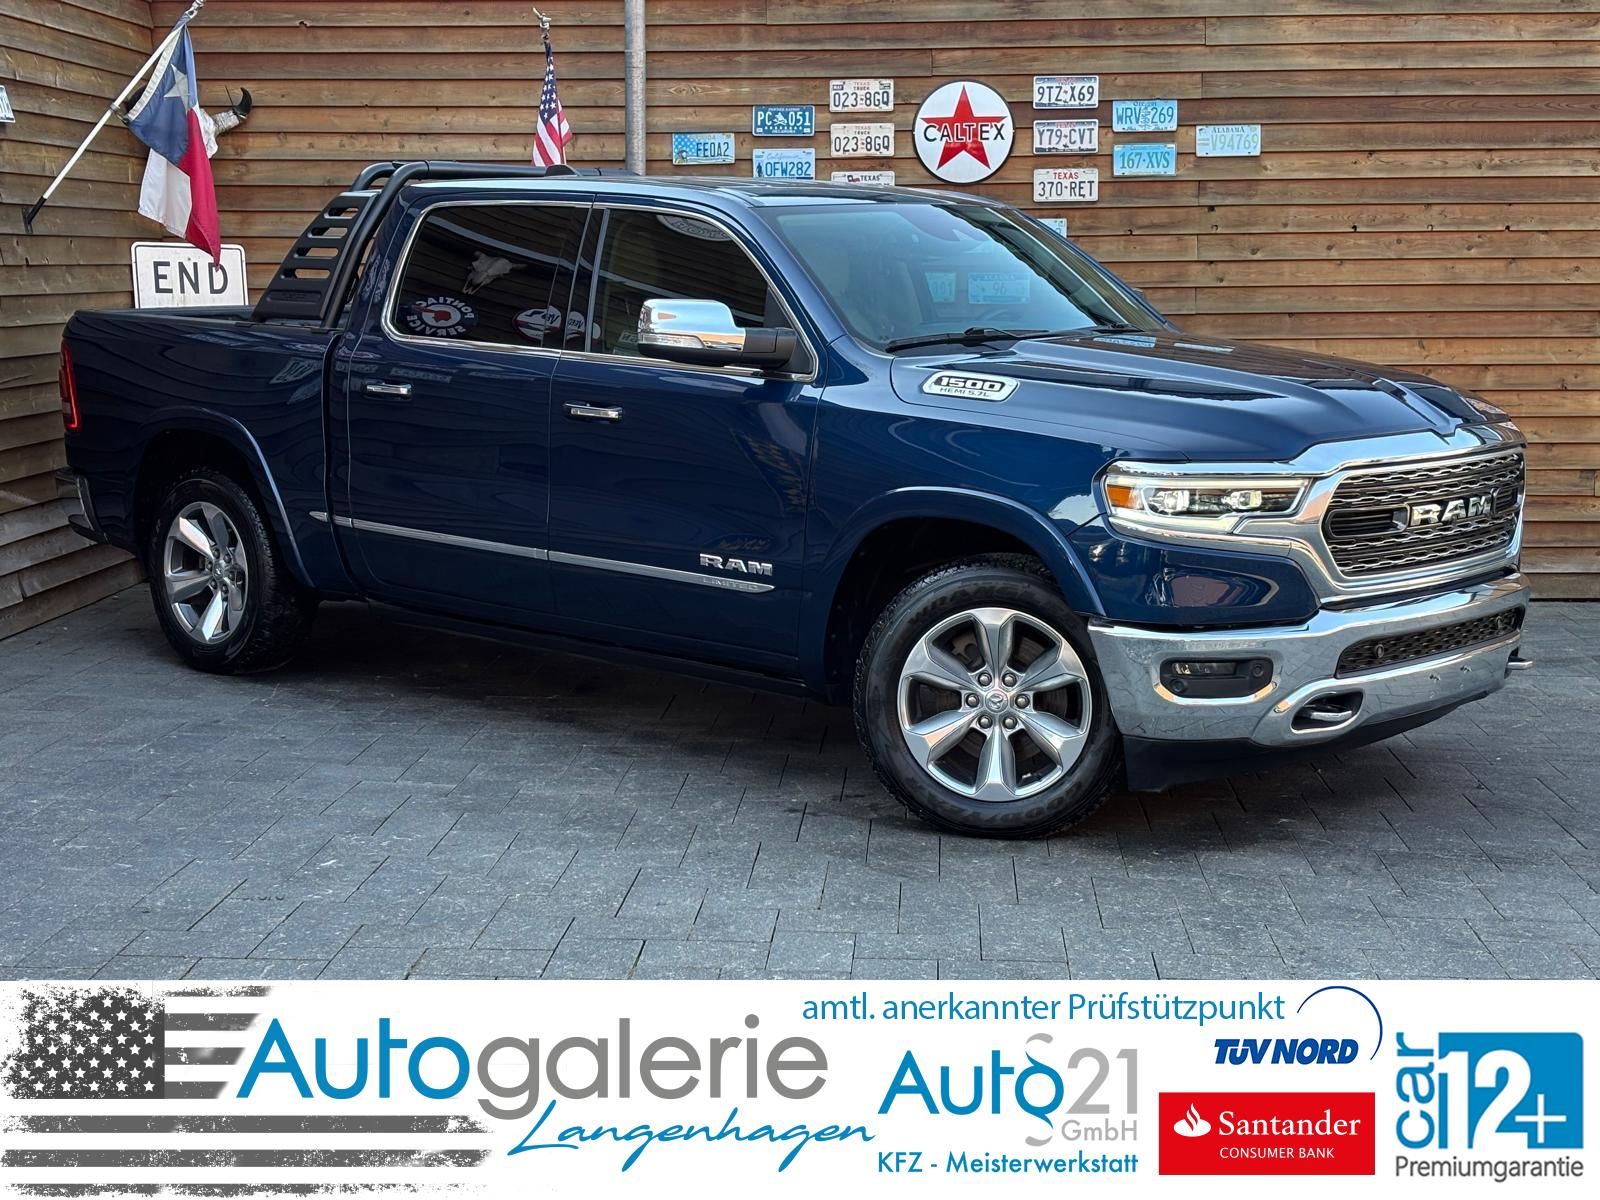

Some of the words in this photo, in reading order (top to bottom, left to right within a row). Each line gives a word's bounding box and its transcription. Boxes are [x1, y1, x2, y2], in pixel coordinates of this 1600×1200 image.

[757, 111, 772, 126] PC
[923, 123, 1006, 142] CALTEX
[860, 174, 880, 182] TEXAS
[1053, 171, 1079, 180] TEXAS
[152, 260, 229, 295] END
[940, 376, 1002, 392] 1500
[1409, 494, 1497, 526] RAM
[699, 553, 773, 576] RAM
